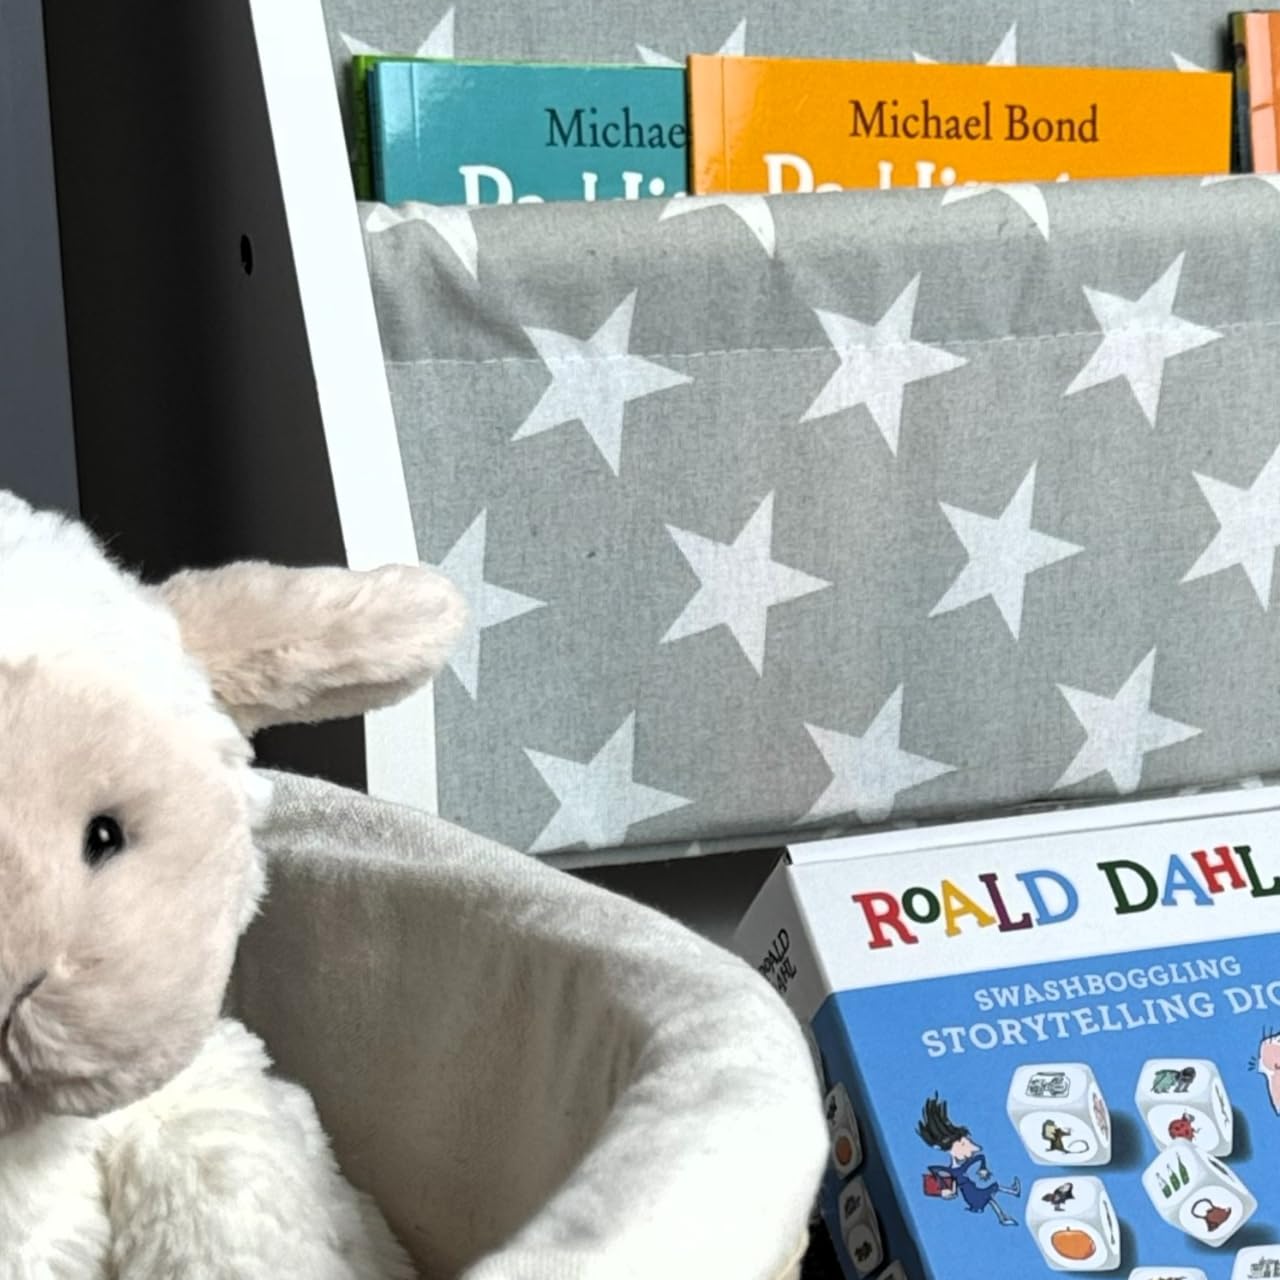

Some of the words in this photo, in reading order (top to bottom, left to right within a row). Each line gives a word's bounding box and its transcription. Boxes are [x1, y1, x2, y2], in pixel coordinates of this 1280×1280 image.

[849, 99, 993, 142] Michael
[1004, 103, 1099, 144] Bond
[852, 873, 1080, 950] ROALD
[973, 955, 1243, 1012] SWASHBOGGLING
[921, 993, 1217, 1059] STORYTELLING
